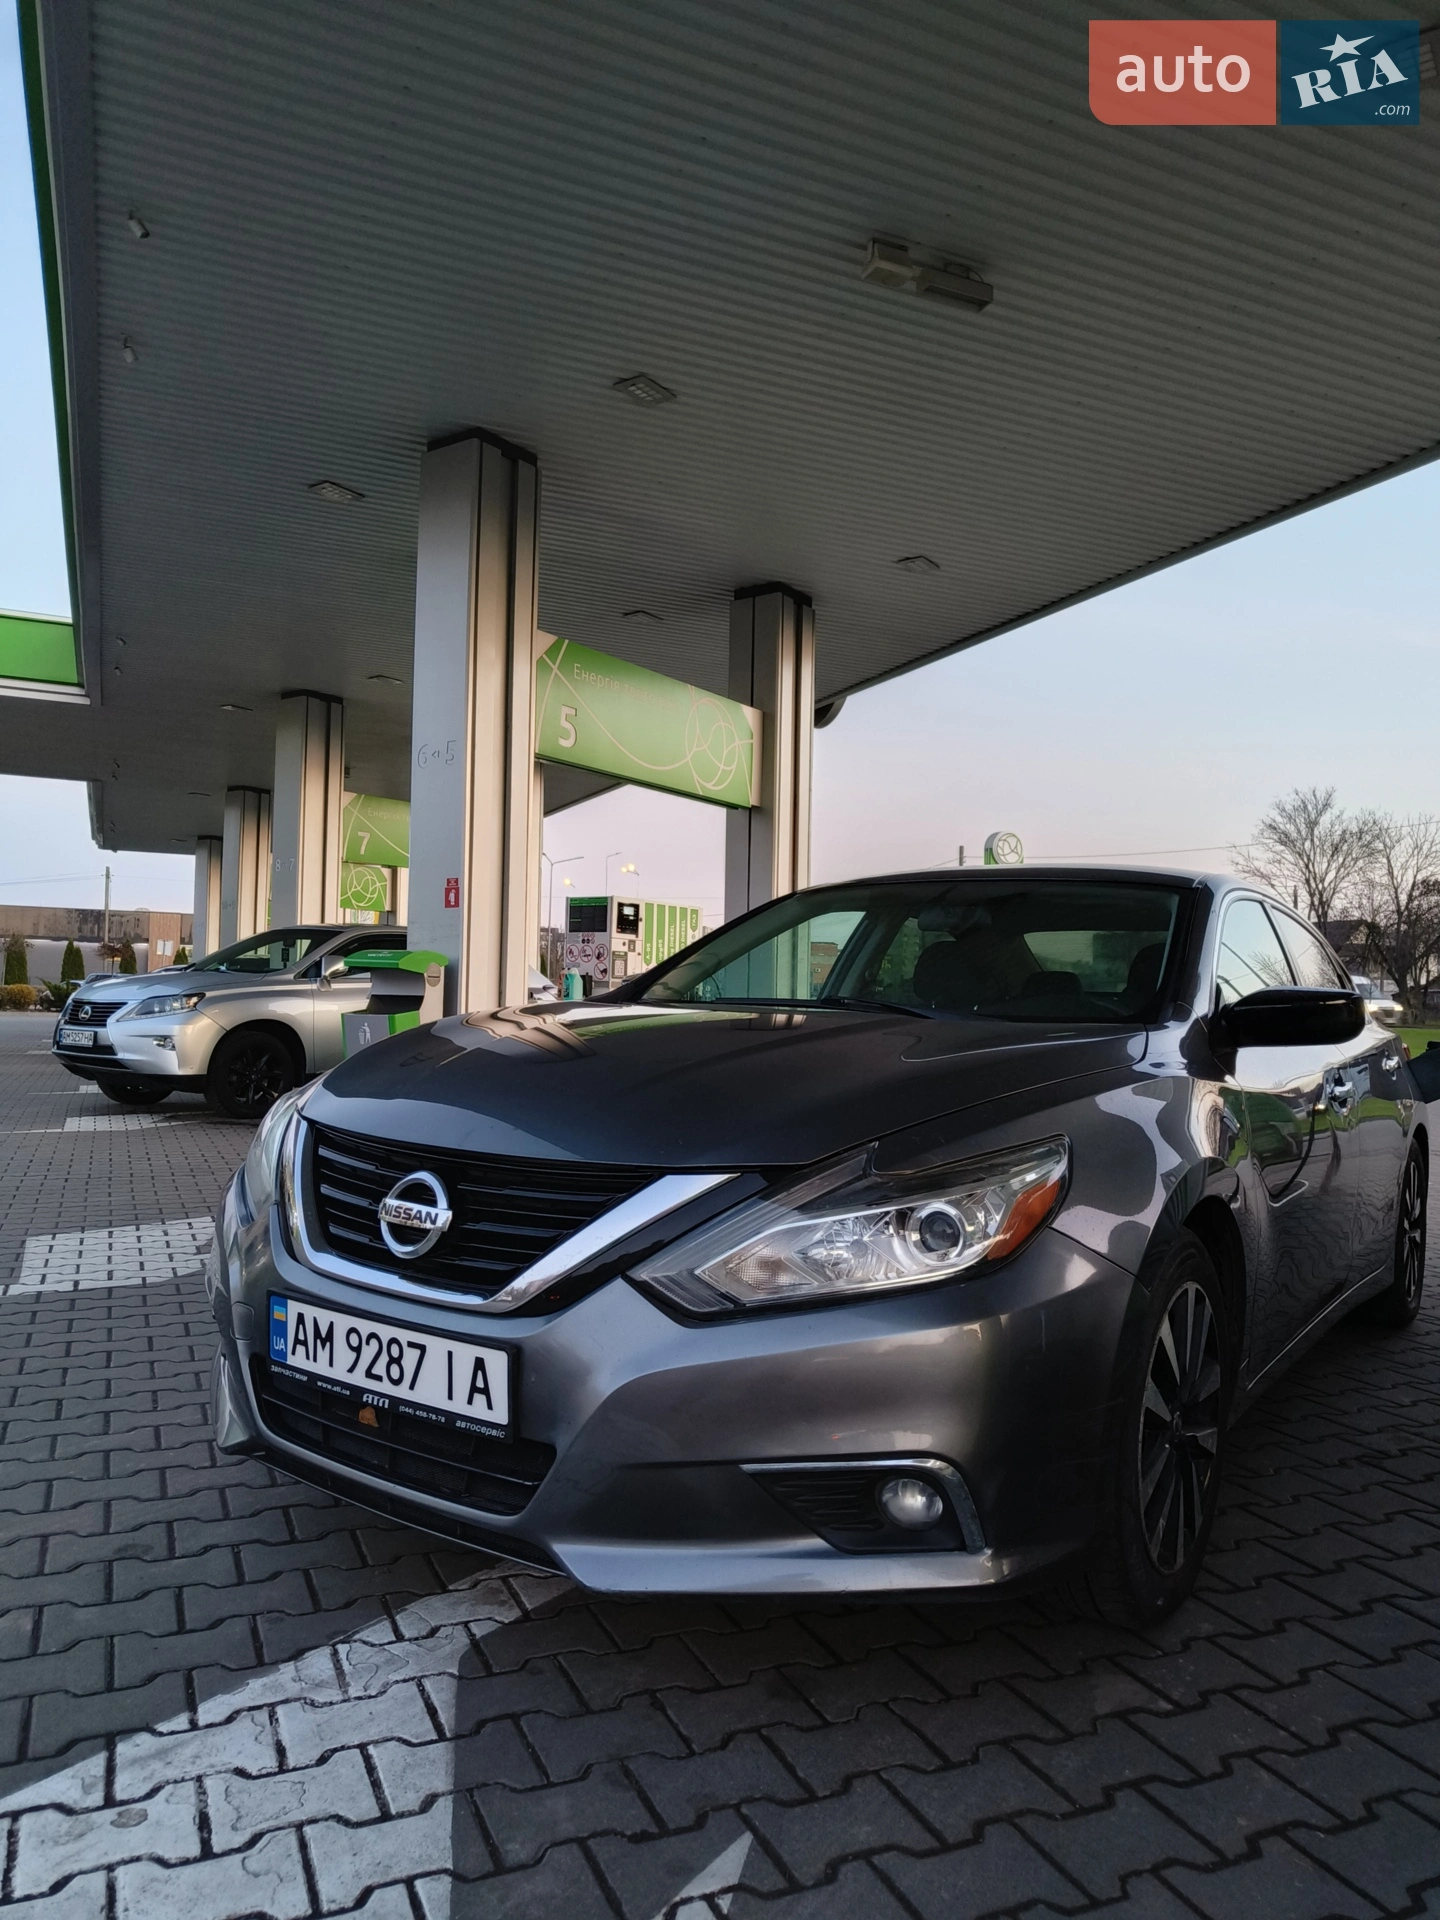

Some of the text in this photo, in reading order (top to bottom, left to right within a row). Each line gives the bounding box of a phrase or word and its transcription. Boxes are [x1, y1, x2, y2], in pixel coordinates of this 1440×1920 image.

[573, 662, 621, 693] Енергія
[557, 704, 578, 748] 5
[357, 831, 371, 855] 7
[275, 858, 295, 872] 8 7
[380, 1202, 439, 1226] NISSAN
[273, 1335, 286, 1353] UA
[291, 1311, 494, 1411] AM 9287 IA
[270, 1364, 308, 1382] запчастини
[316, 1380, 351, 1396] www.atl.ua
[455, 1419, 506, 1439] автосервіс
